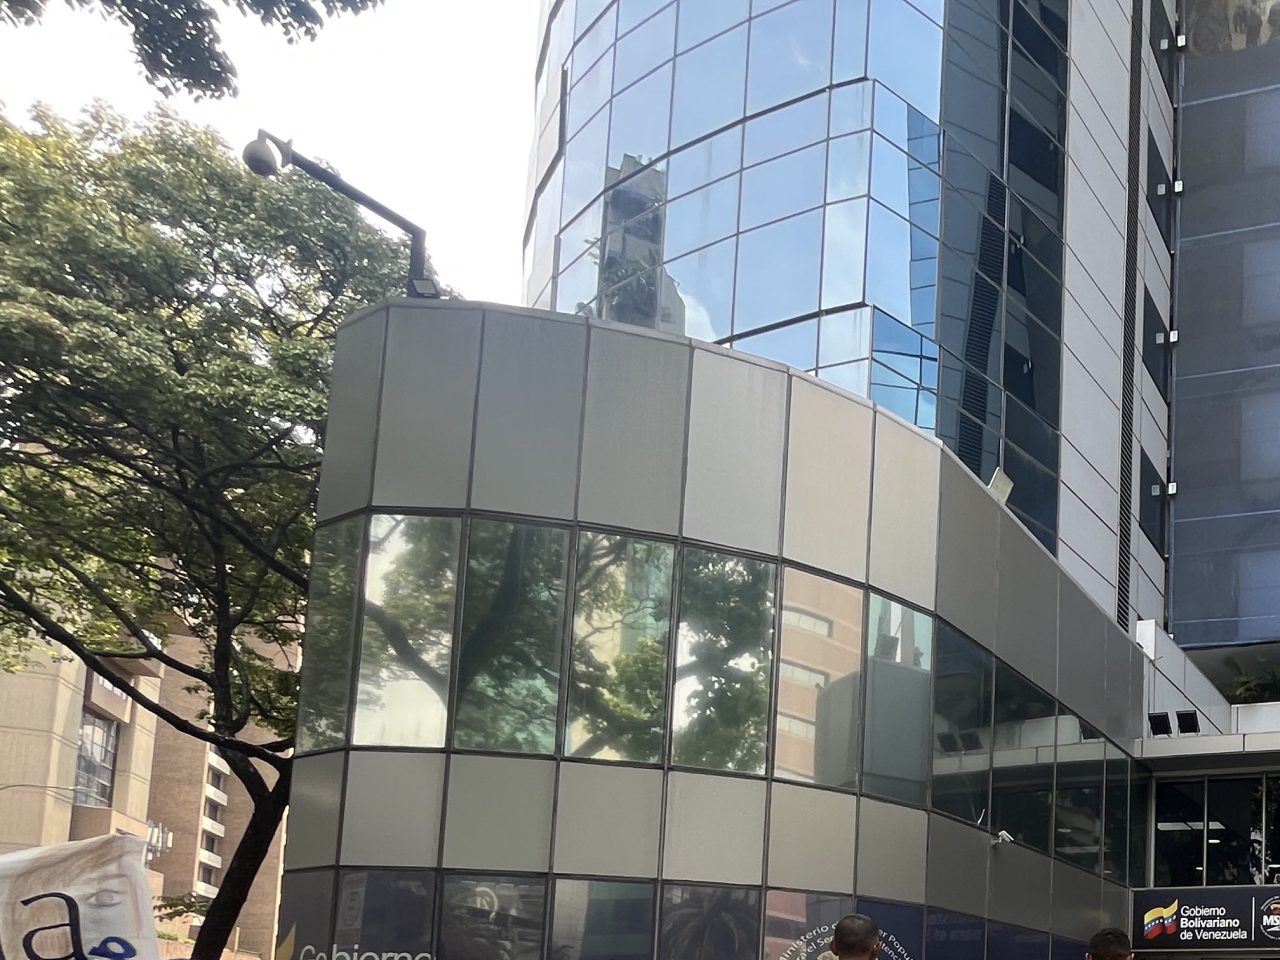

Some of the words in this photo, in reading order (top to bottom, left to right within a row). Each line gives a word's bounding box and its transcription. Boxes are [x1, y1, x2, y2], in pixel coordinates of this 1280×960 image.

[1181, 905, 1226, 917] Gobierno
[1180, 917, 1240, 929] Bolivariano
[1180, 930, 1194, 941] de
[1196, 928, 1248, 941] Venezuela
[807, 942, 817, 953] el
